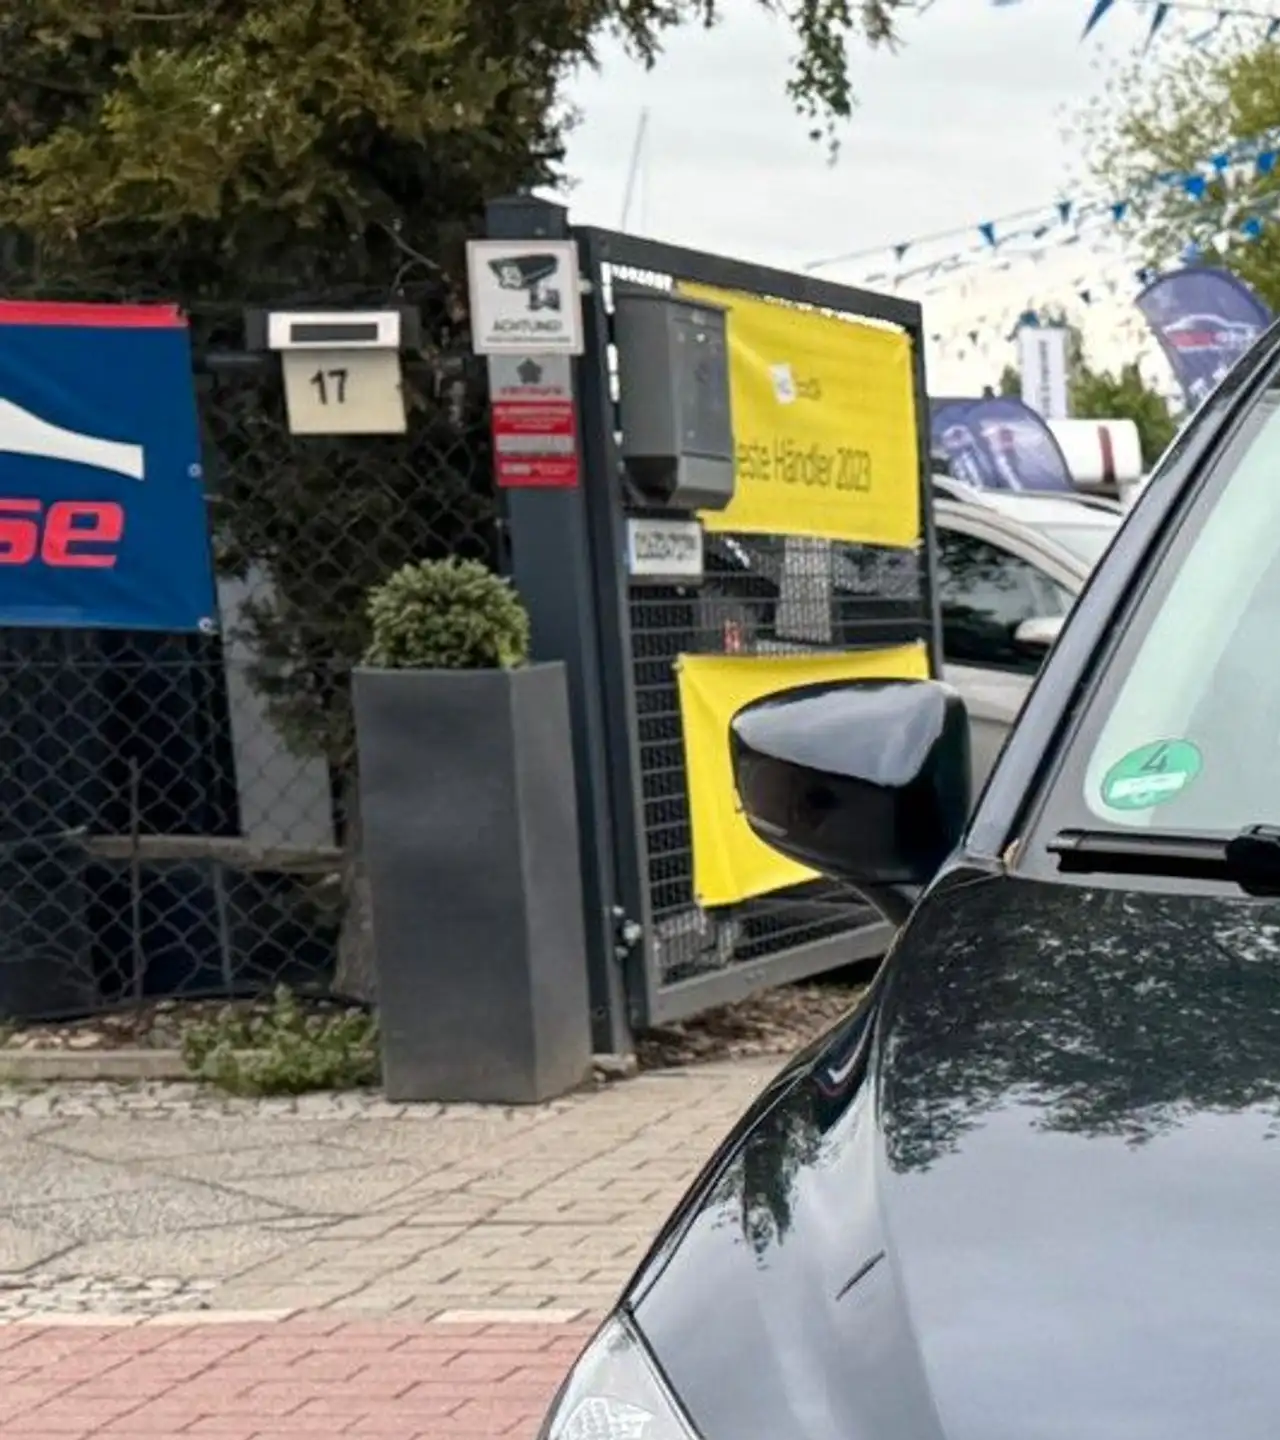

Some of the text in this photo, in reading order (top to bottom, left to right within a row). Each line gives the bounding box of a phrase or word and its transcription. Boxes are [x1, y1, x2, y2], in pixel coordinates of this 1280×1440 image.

[310, 368, 348, 406] 17
[773, 434, 834, 488] Händler
[1140, 742, 1170, 774] 4
